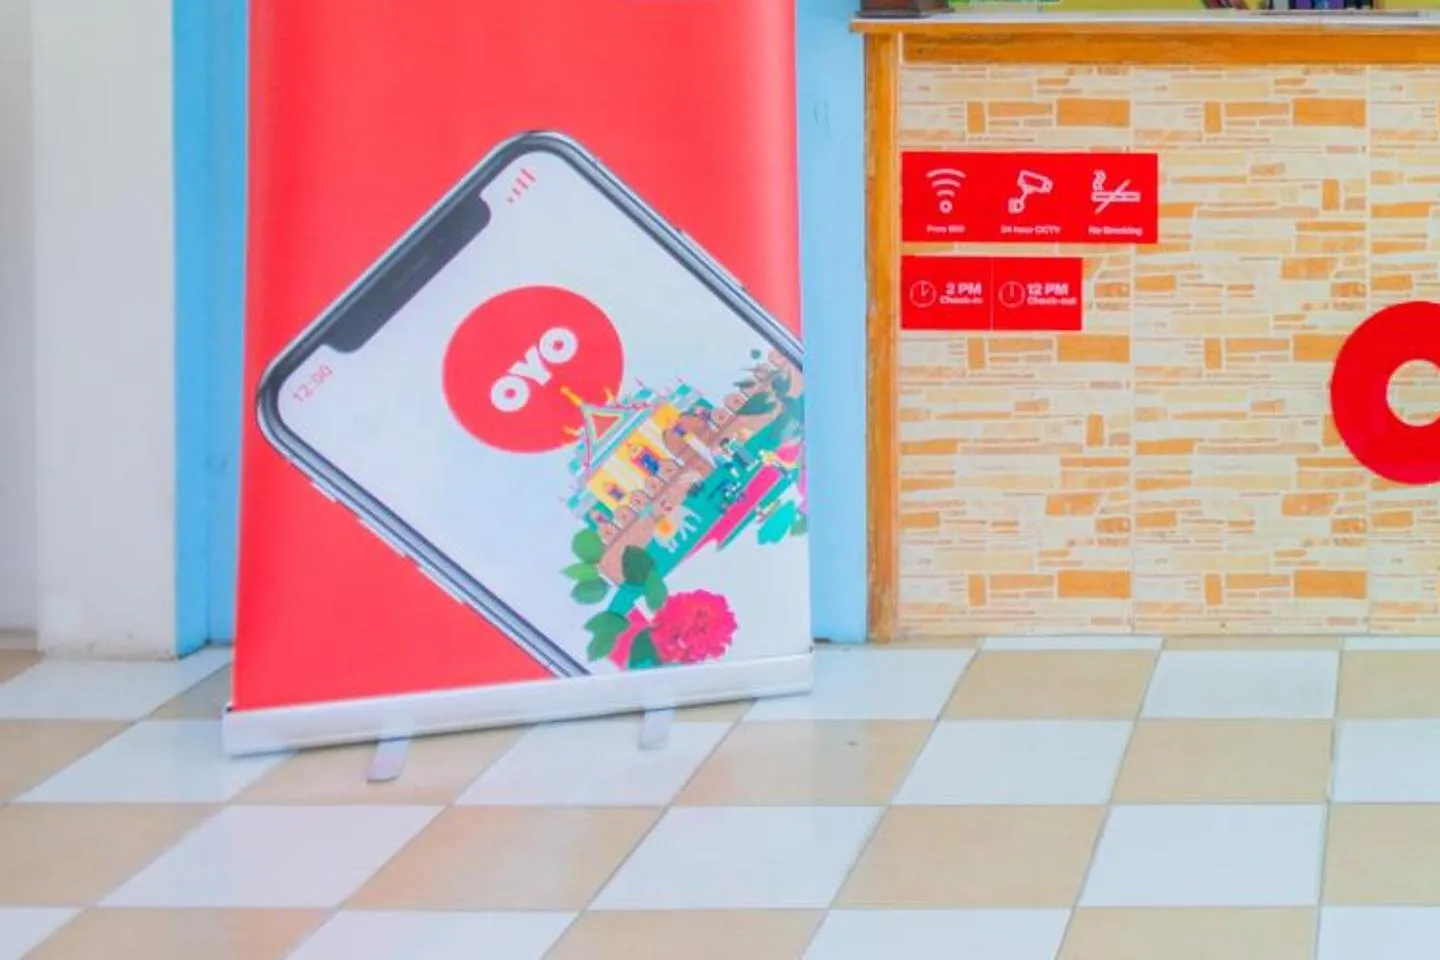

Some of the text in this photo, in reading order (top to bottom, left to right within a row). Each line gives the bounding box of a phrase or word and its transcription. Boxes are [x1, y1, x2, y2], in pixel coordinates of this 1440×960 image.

[945, 282, 983, 296] 2 PM
[1027, 283, 1070, 296] 12 PM
[490, 326, 579, 413] OYO
